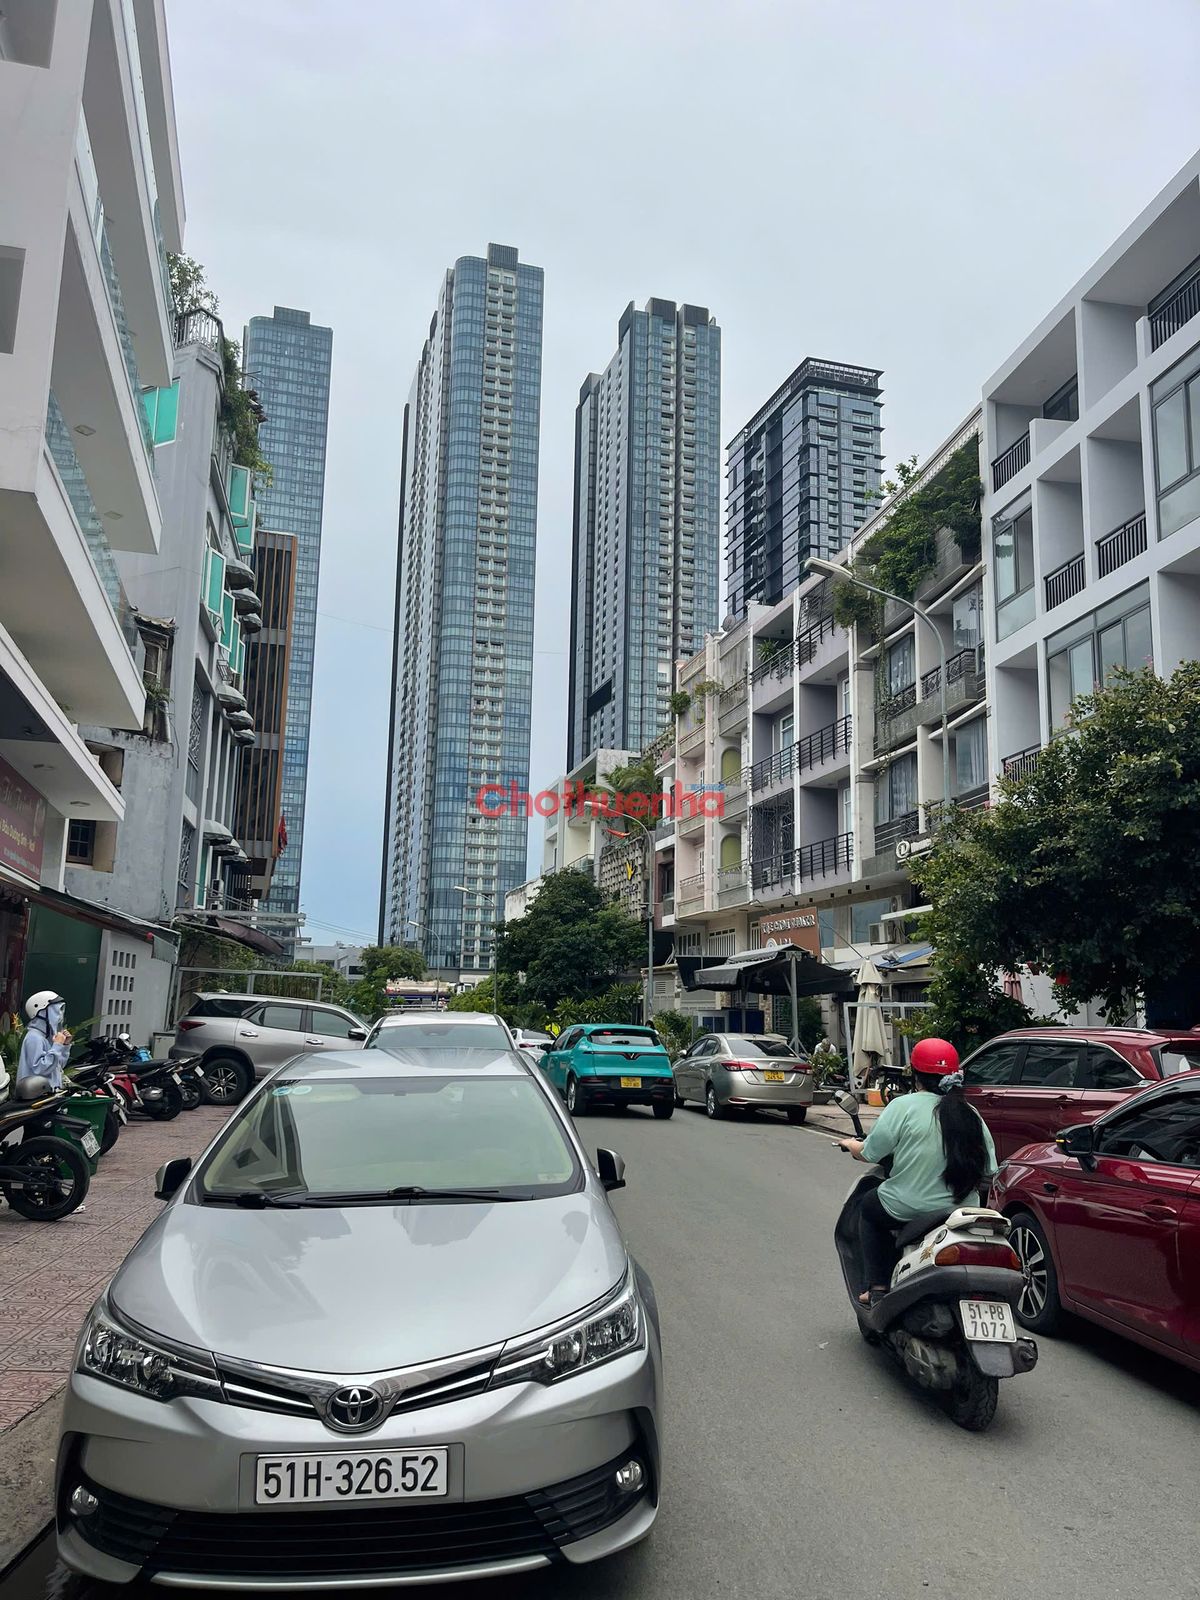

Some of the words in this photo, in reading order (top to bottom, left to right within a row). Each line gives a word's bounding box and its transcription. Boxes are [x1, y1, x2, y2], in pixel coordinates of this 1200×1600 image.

[968, 1303, 1004, 1320] 51-P8
[971, 1321, 1008, 1339] 7072
[264, 1455, 438, 1498] 51H-326.52
